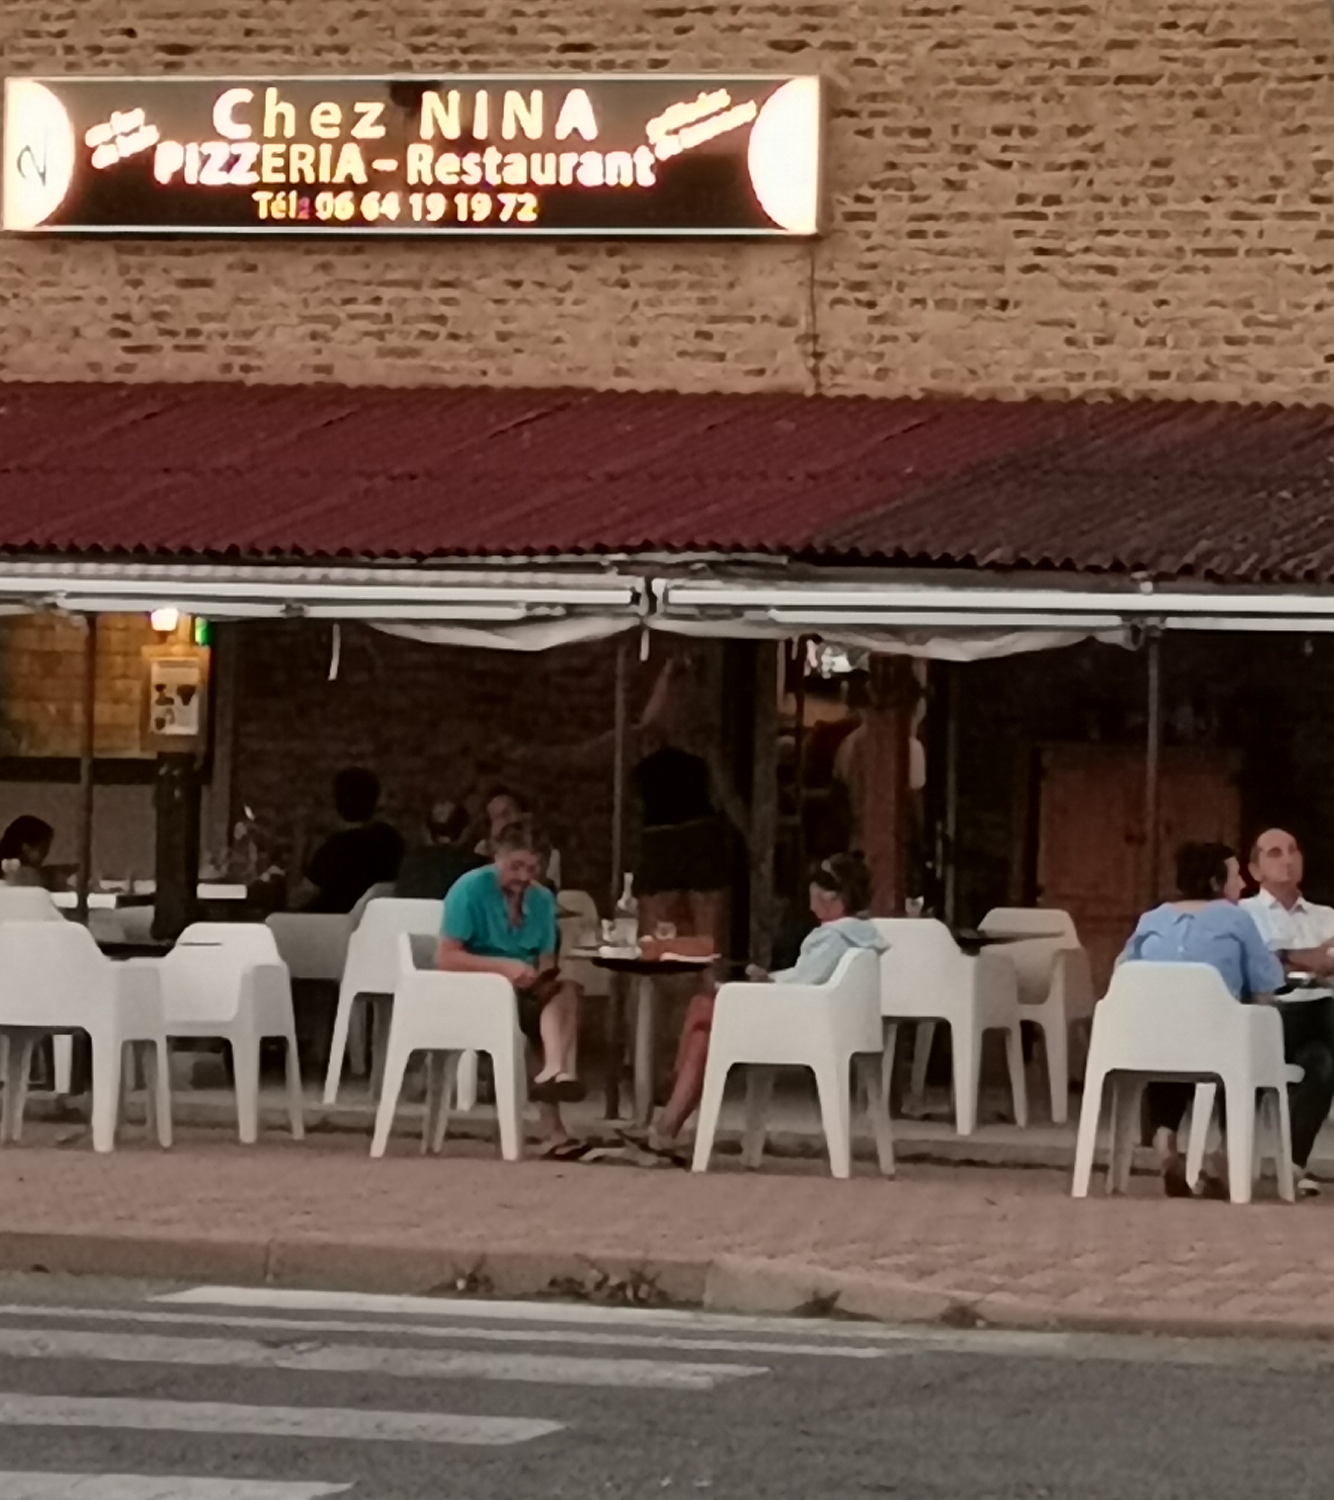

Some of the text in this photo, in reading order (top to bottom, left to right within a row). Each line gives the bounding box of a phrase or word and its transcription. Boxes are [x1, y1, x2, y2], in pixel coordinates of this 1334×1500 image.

[213, 87, 386, 139] Chez
[420, 88, 598, 141] NINA
[154, 141, 368, 185] PIZZERIA
[407, 143, 657, 187] Restaurant
[409, 192, 447, 222] 19
[454, 192, 492, 222] 19
[497, 192, 539, 223] 72
